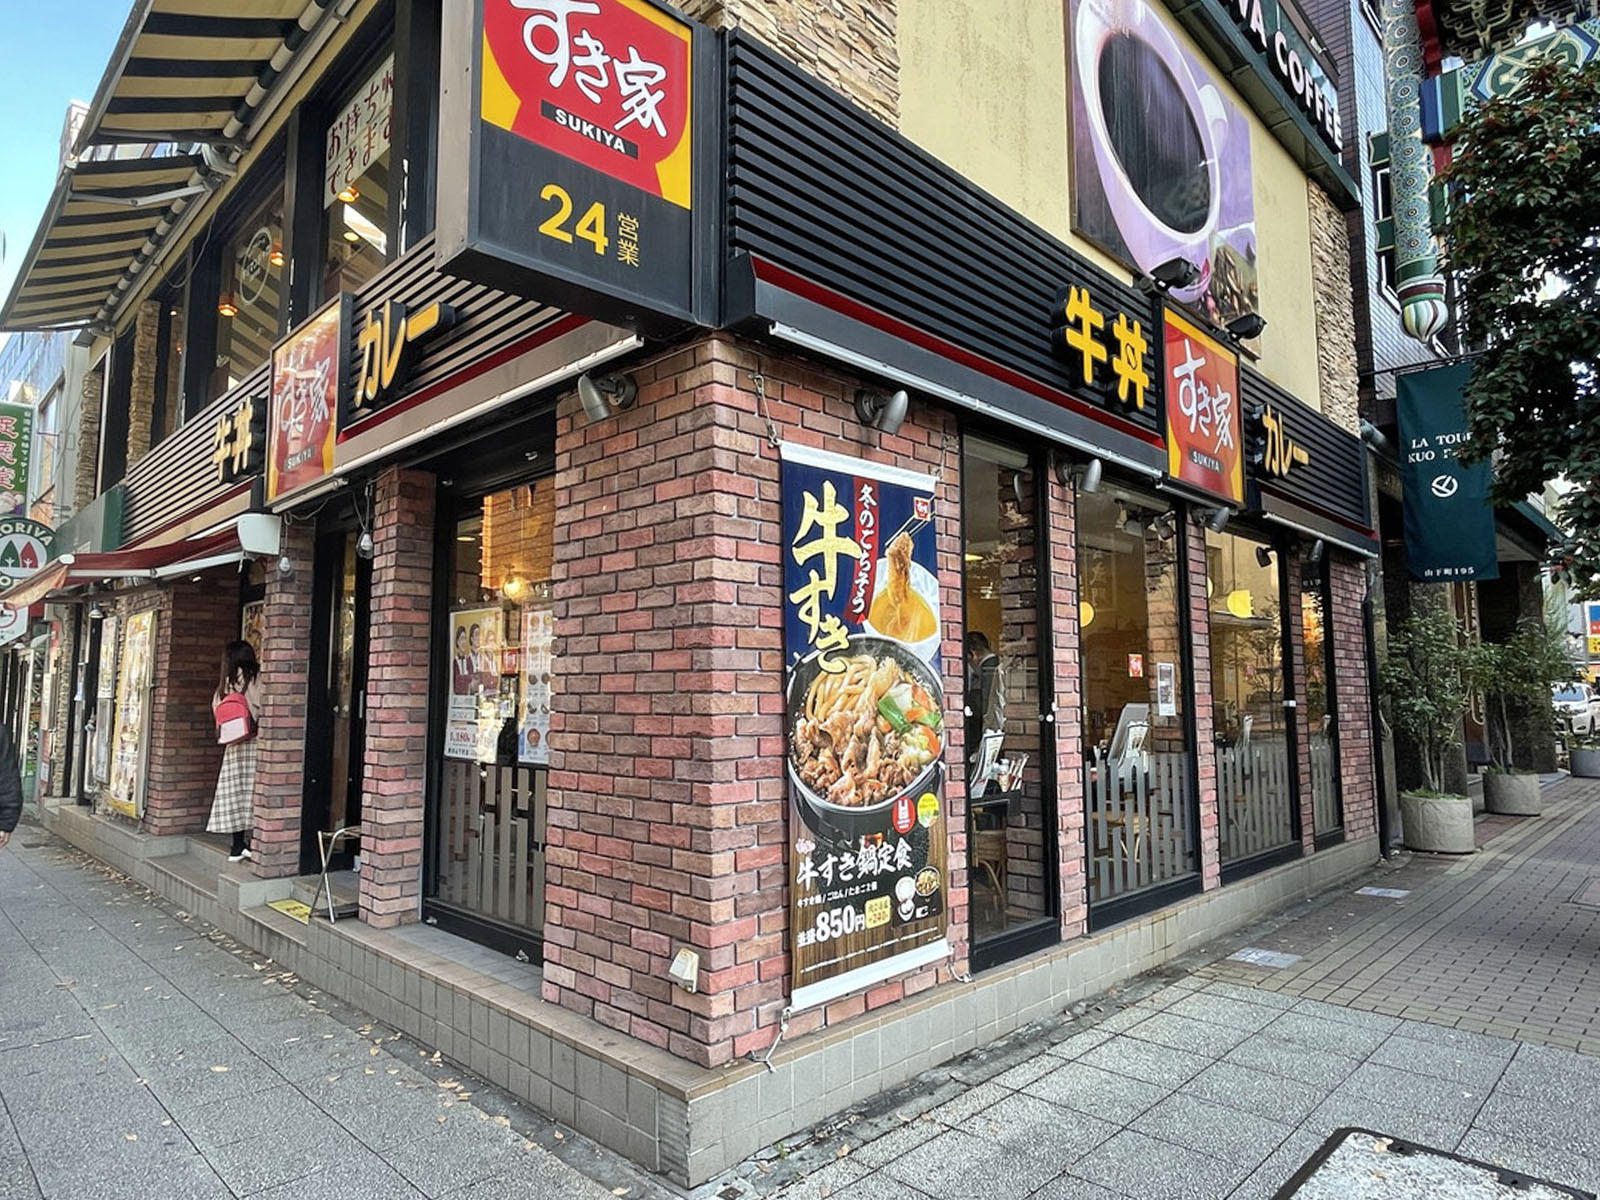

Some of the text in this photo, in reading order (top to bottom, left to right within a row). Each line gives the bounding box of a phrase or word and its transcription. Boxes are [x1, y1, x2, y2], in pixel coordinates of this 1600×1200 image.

[509, 0, 667, 137] すき家
[1275, 31, 1342, 150] COFFEE
[555, 109, 626, 153] SUKIYA
[538, 184, 640, 267] 24 営業
[355, 300, 441, 407] カレー
[1066, 286, 1149, 410] 牛丼
[212, 394, 254, 483] 牛丼
[279, 349, 331, 442] すき家
[1173, 338, 1234, 454] すき家
[287, 446, 313, 470] SUKIYA
[1192, 451, 1221, 473] SUKIYA
[1262, 404, 1310, 477] カレー
[1408, 450, 1436, 463] KUO
[1411, 437, 1428, 449] LA
[0, 522, 54, 547] ORIVA
[789, 479, 866, 673] 牛すき
[852, 483, 879, 614] 冬のごちそう
[796, 837, 913, 892] 牛すき鍋定食
